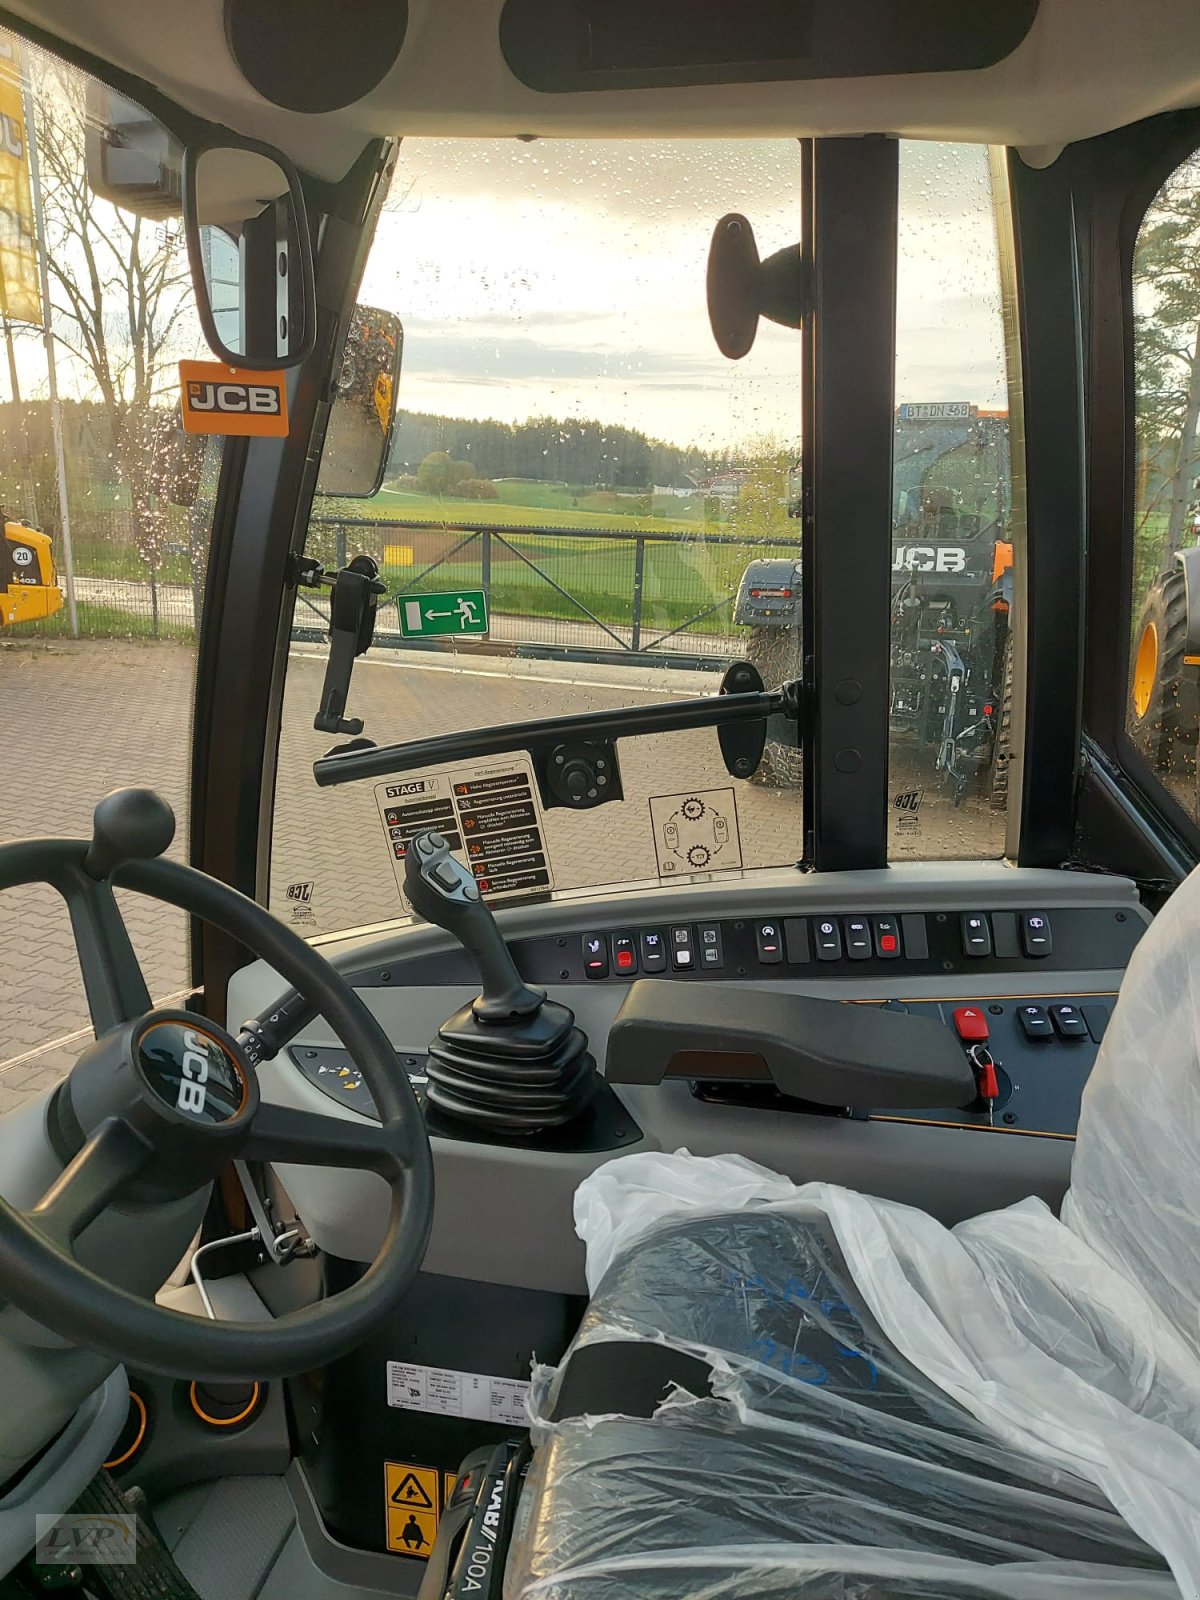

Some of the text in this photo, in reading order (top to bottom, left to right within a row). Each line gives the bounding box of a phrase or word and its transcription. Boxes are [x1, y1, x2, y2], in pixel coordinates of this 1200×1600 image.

[190, 384, 278, 412] JCB
[907, 406, 922, 417] BT
[929, 405, 945, 417] DN
[16, 551, 28, 561] 20
[386, 780, 435, 797] STAGE V
[177, 1029, 209, 1115] JCB
